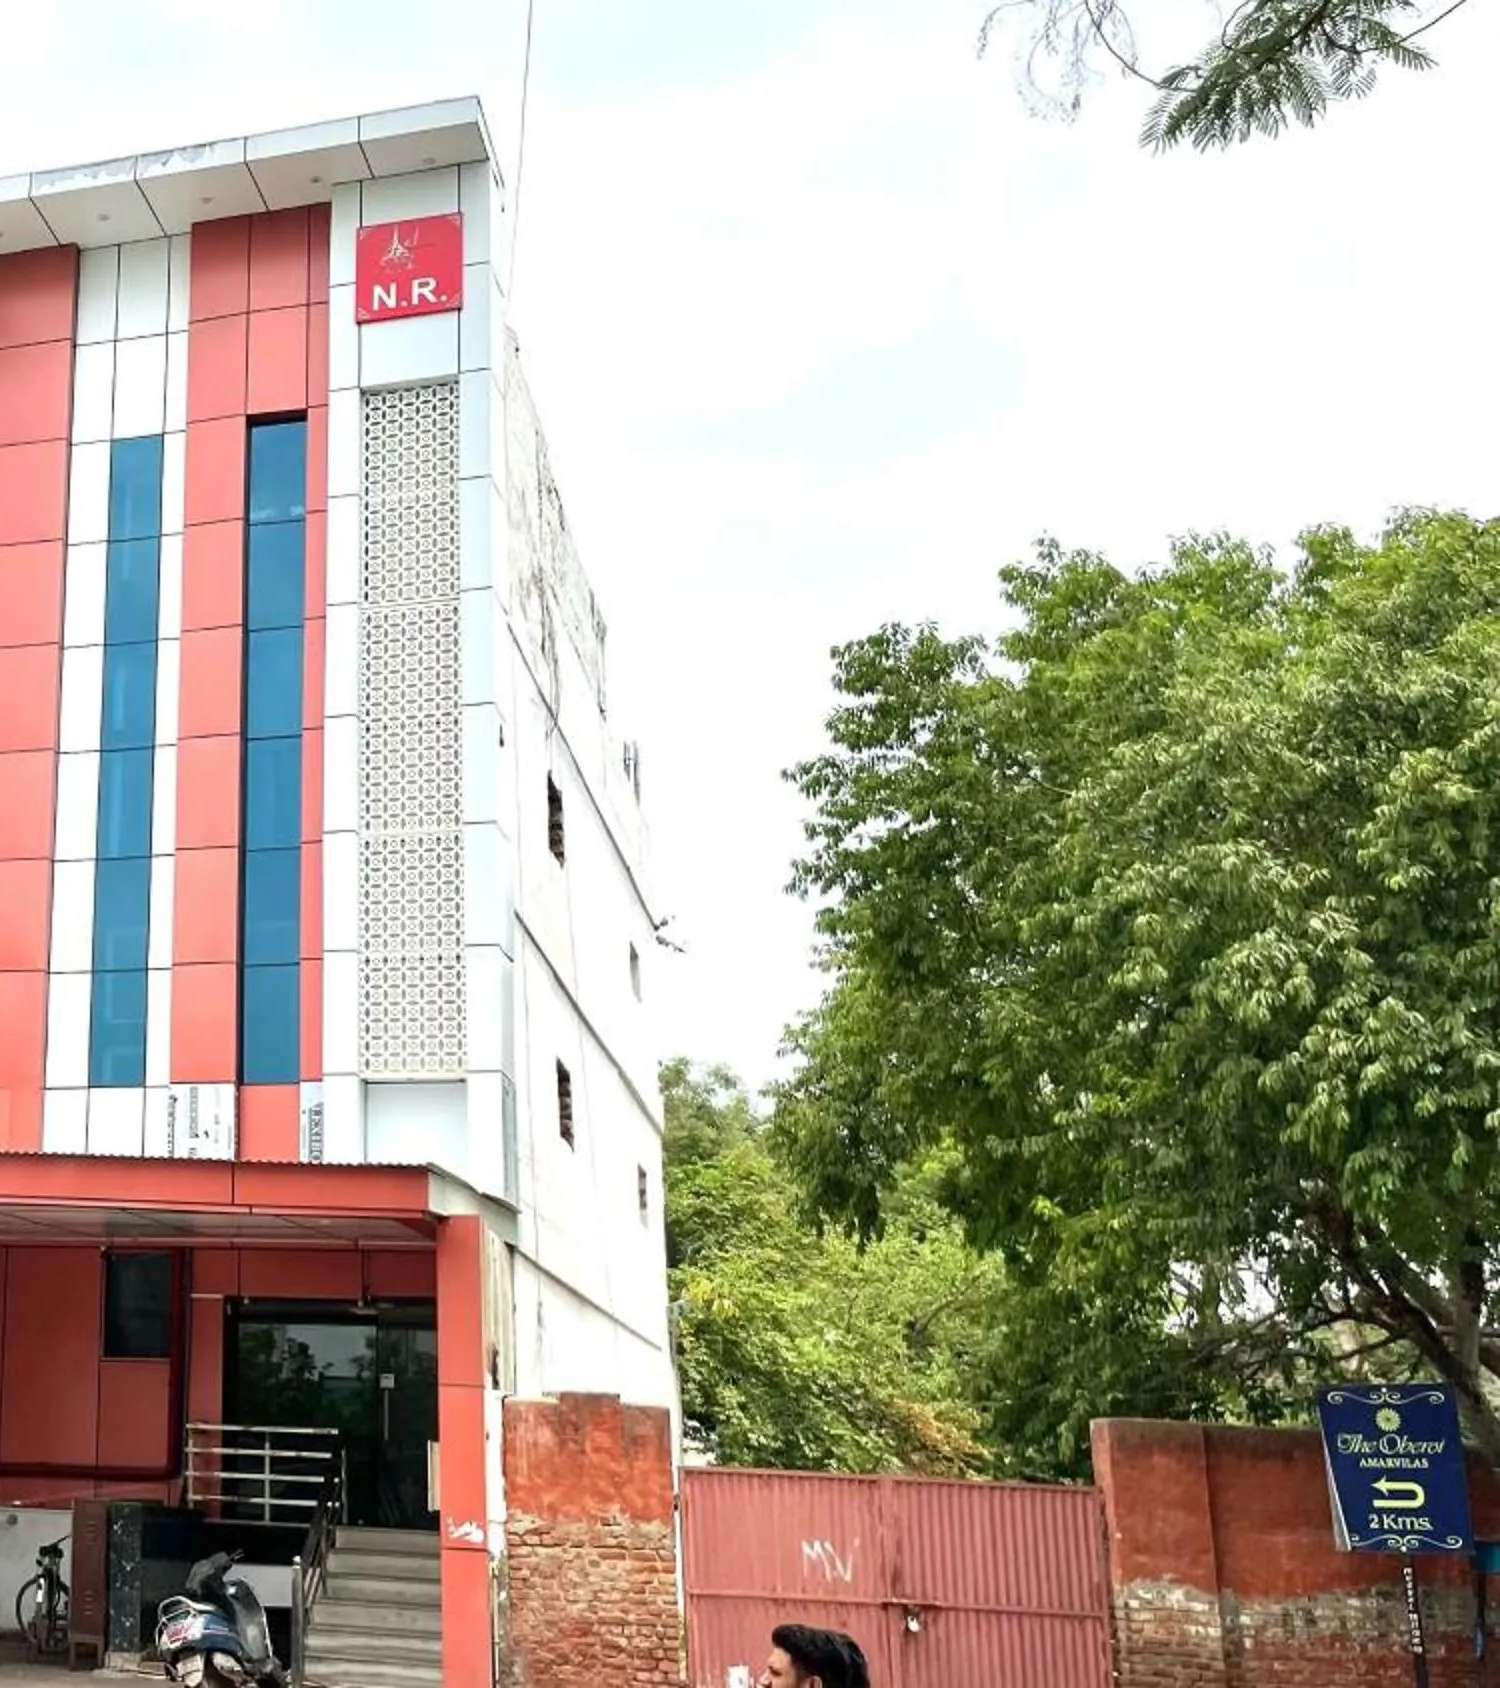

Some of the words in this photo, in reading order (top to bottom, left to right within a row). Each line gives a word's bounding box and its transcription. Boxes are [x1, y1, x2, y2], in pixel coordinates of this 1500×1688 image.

[371, 276, 448, 312] N.R.
[1337, 1433, 1377, 1455] The
[1379, 1433, 1445, 1455] Oberoi
[1359, 1457, 1429, 1469] AMARVILAS
[1367, 1513, 1380, 1530] 2
